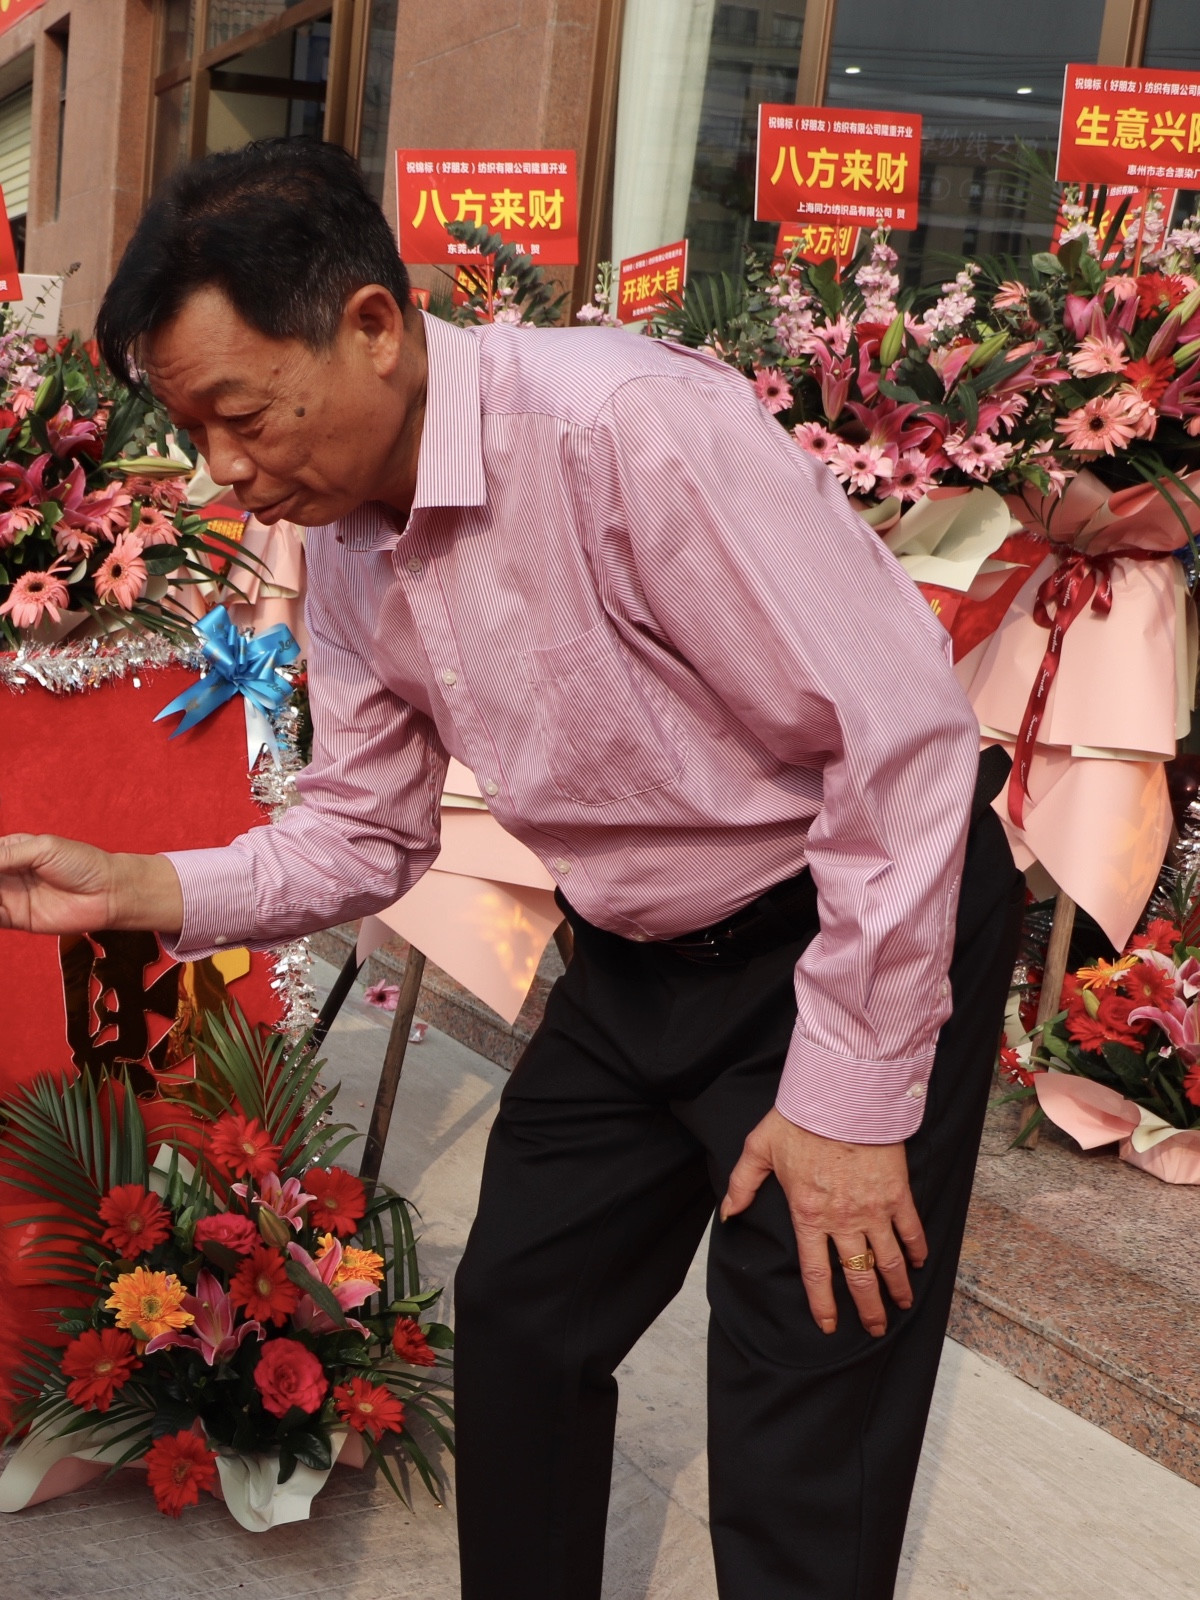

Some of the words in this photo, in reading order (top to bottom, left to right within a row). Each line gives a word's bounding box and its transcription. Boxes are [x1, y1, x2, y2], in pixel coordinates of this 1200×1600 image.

[1075, 77, 1200, 97] 祝锦标（好朋友）纺织有限公司
[770, 146, 909, 194] 八方来财
[411, 188, 565, 230] 八方来财
[622, 266, 680, 305] 开张大吉
